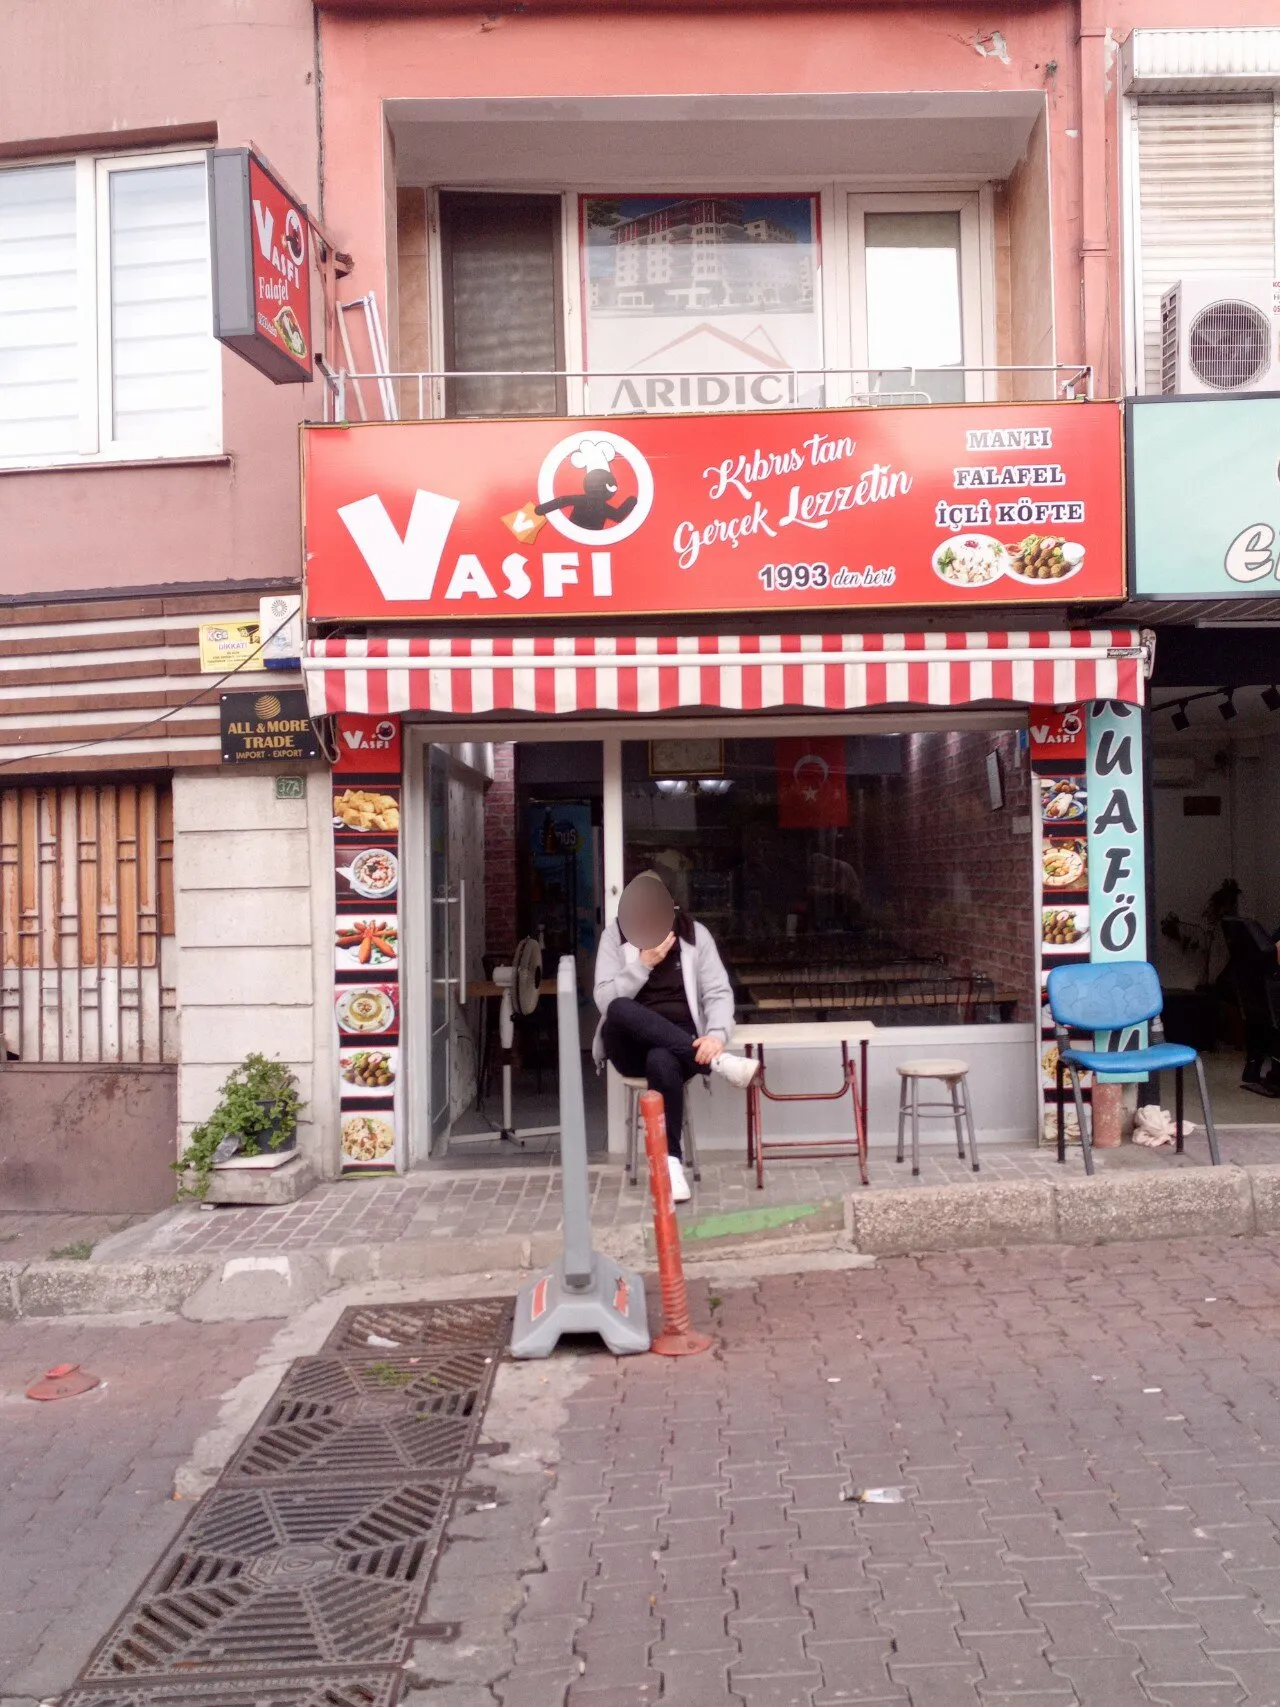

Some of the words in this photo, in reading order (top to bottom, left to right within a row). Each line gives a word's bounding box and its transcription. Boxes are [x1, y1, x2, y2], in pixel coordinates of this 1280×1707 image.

[259, 276, 289, 305] Falafel
[803, 433, 857, 466] tan
[968, 430, 1050, 449] MANTI
[956, 467, 1063, 487] FALAFEL
[673, 500, 778, 570] Gerçek
[778, 463, 913, 530] Lezzetin
[938, 502, 989, 529] İÇLİ
[998, 500, 1083, 522] KÖFTE
[336, 488, 613, 601] VASFI
[761, 564, 828, 588] 1993
[833, 566, 861, 586] den
[863, 564, 894, 585] beri
[228, 721, 254, 735] ALL
[256, 723, 266, 733] &
[267, 720, 310, 733] MORE
[236, 751, 265, 759] IMPORT
[273, 750, 302, 758] EXPORT
[244, 736, 295, 749] TRADE
